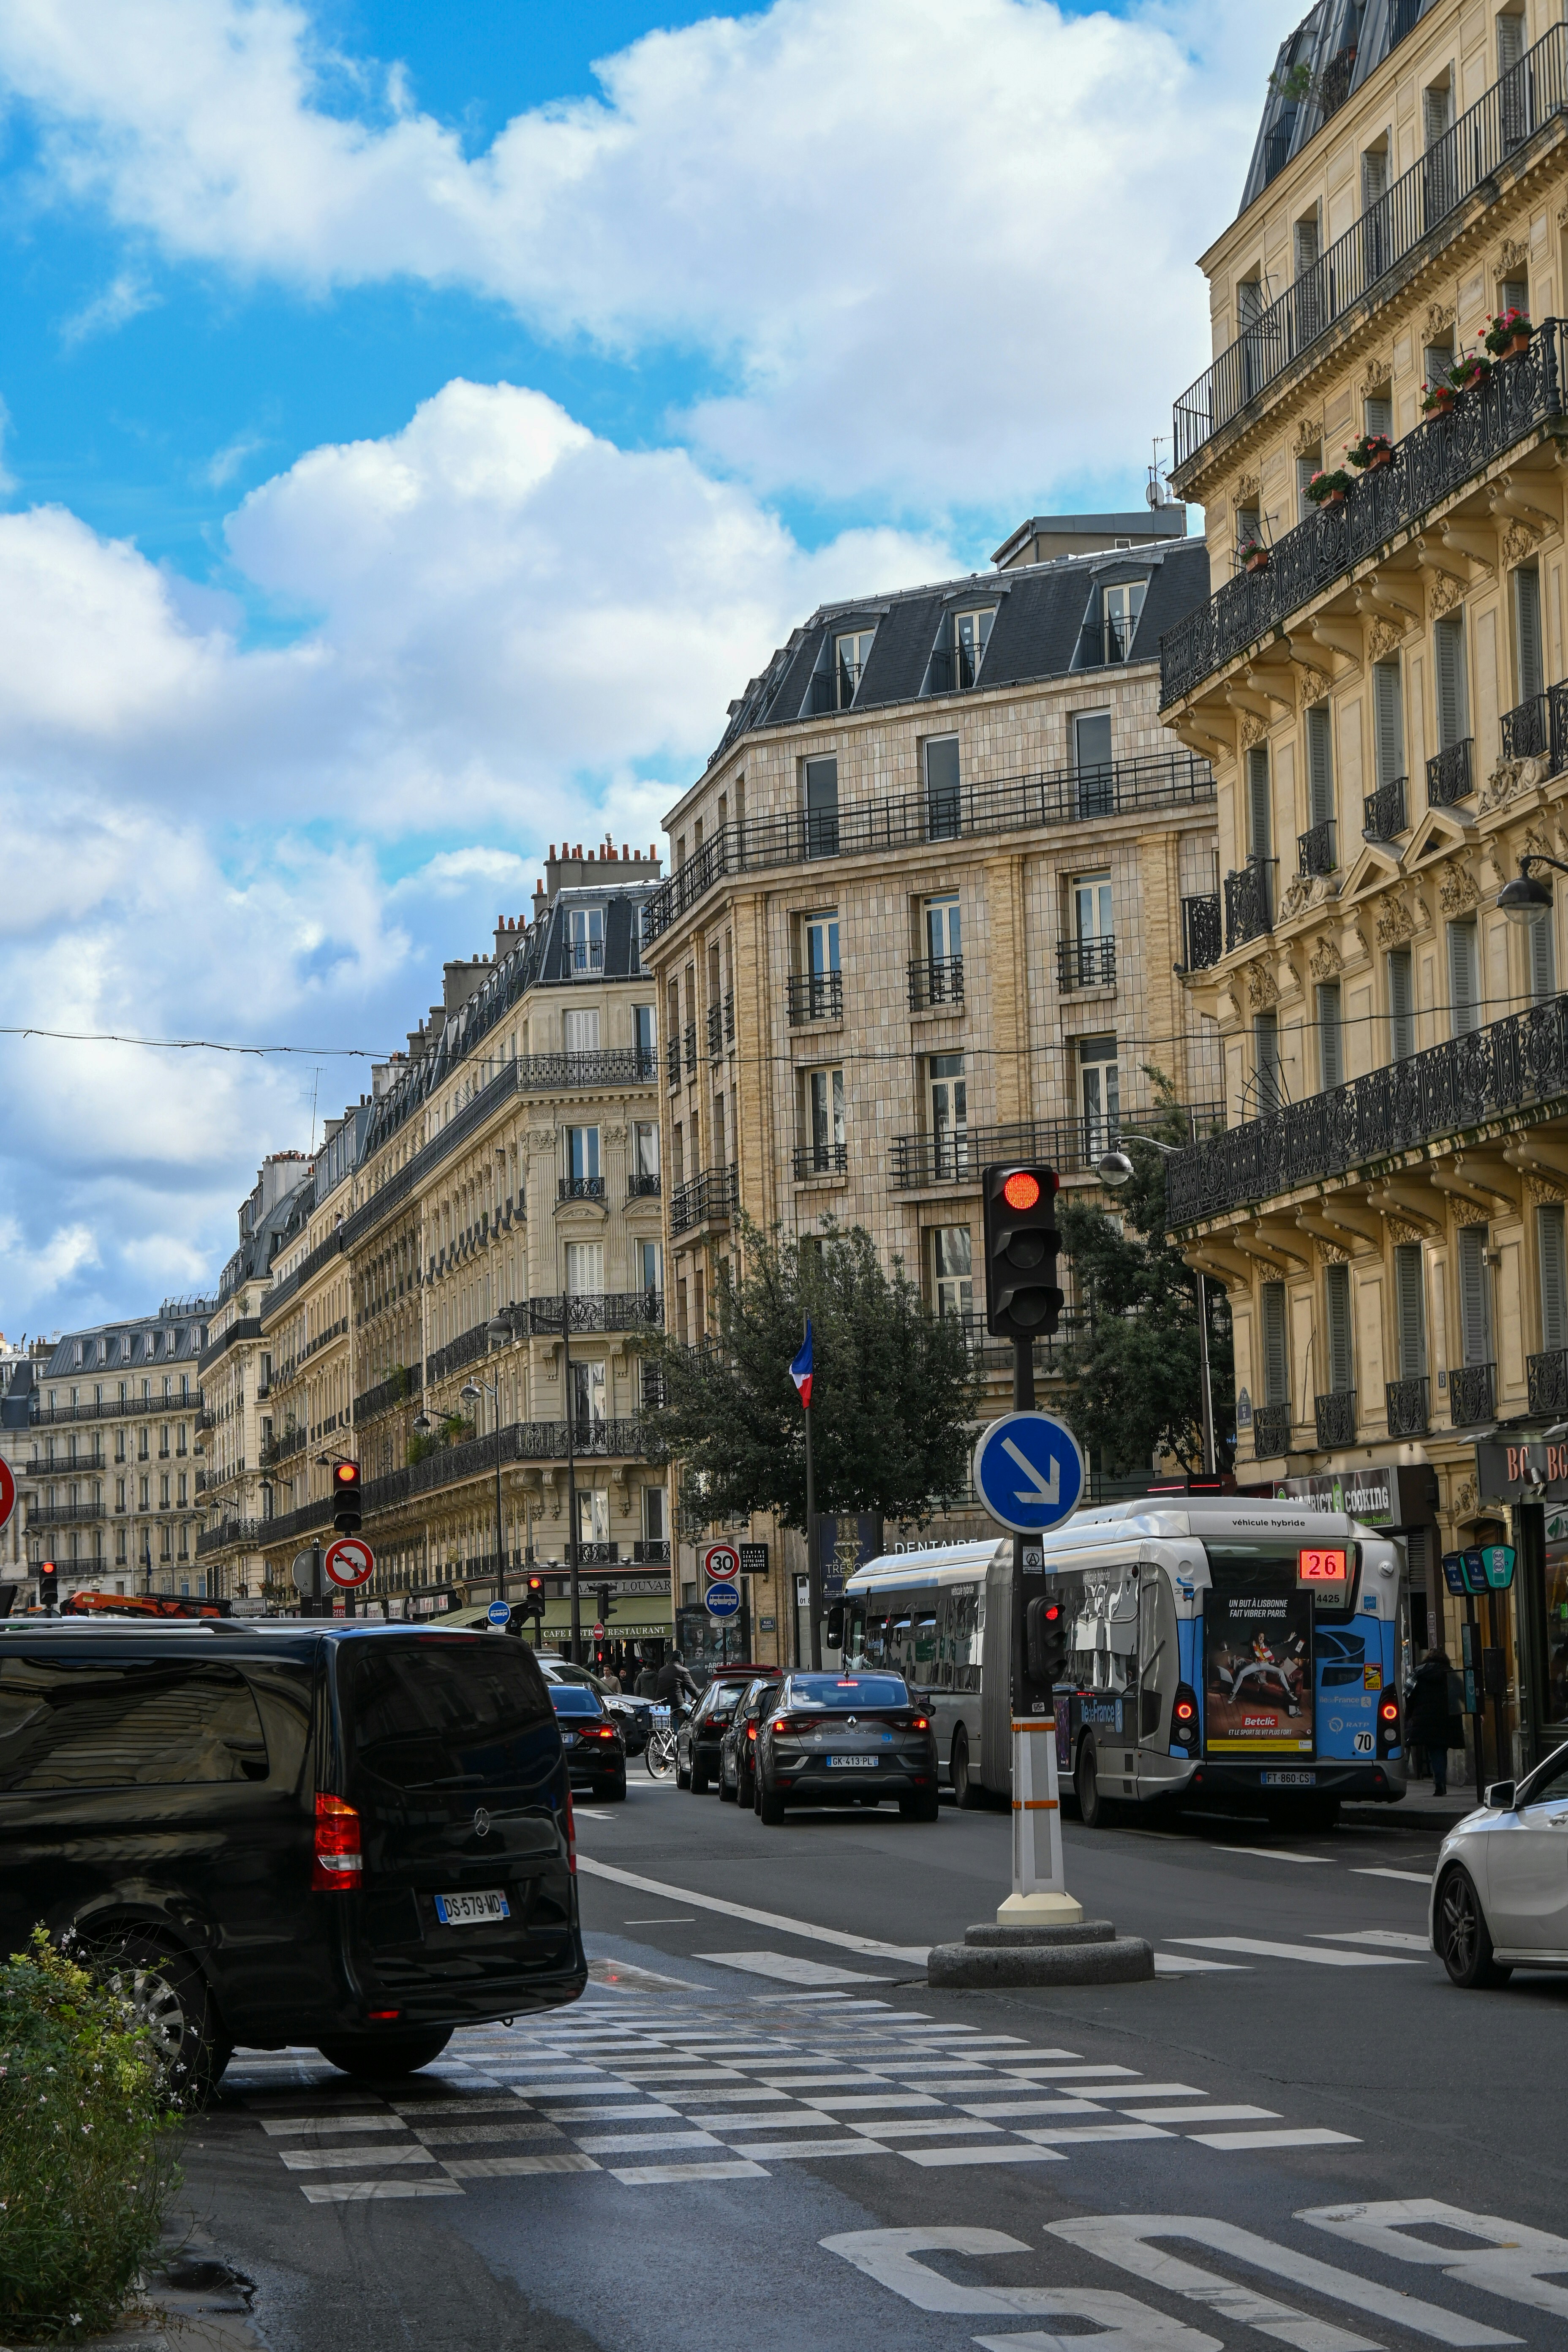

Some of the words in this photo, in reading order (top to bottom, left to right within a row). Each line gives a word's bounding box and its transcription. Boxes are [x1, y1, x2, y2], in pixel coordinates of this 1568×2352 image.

[1440, 1373, 1445, 1386] 15
[1372, 1515, 1383, 1524] Street
[1383, 1514, 1392, 1523] Food
[712, 1555, 733, 1571] 30
[1309, 1555, 1336, 1575] 26
[1083, 1570, 1097, 1583] véhicule
[1097, 1568, 1110, 1584] hybride
[1229, 1599, 1238, 1608] UN
[1239, 1599, 1252, 1608] BUT
[1252, 1598, 1256, 1608] À
[1257, 1599, 1288, 1608] LISBONNE
[1317, 1595, 1339, 1603] 4425
[1230, 1609, 1244, 1617] FAIT
[1244, 1609, 1266, 1617] VIBRER
[1267, 1609, 1287, 1617] PARIS.
[543, 1630, 566, 1638] CAFE
[608, 1627, 665, 1636] RESTAURANT
[1244, 1717, 1275, 1726] Betclic
[1358, 1734, 1372, 1750] 70
[833, 1757, 872, 1765] GK-413-PL
[1268, 1774, 1309, 1783] FT-860-CS
[444, 1895, 501, 1918] DS-579-MD
